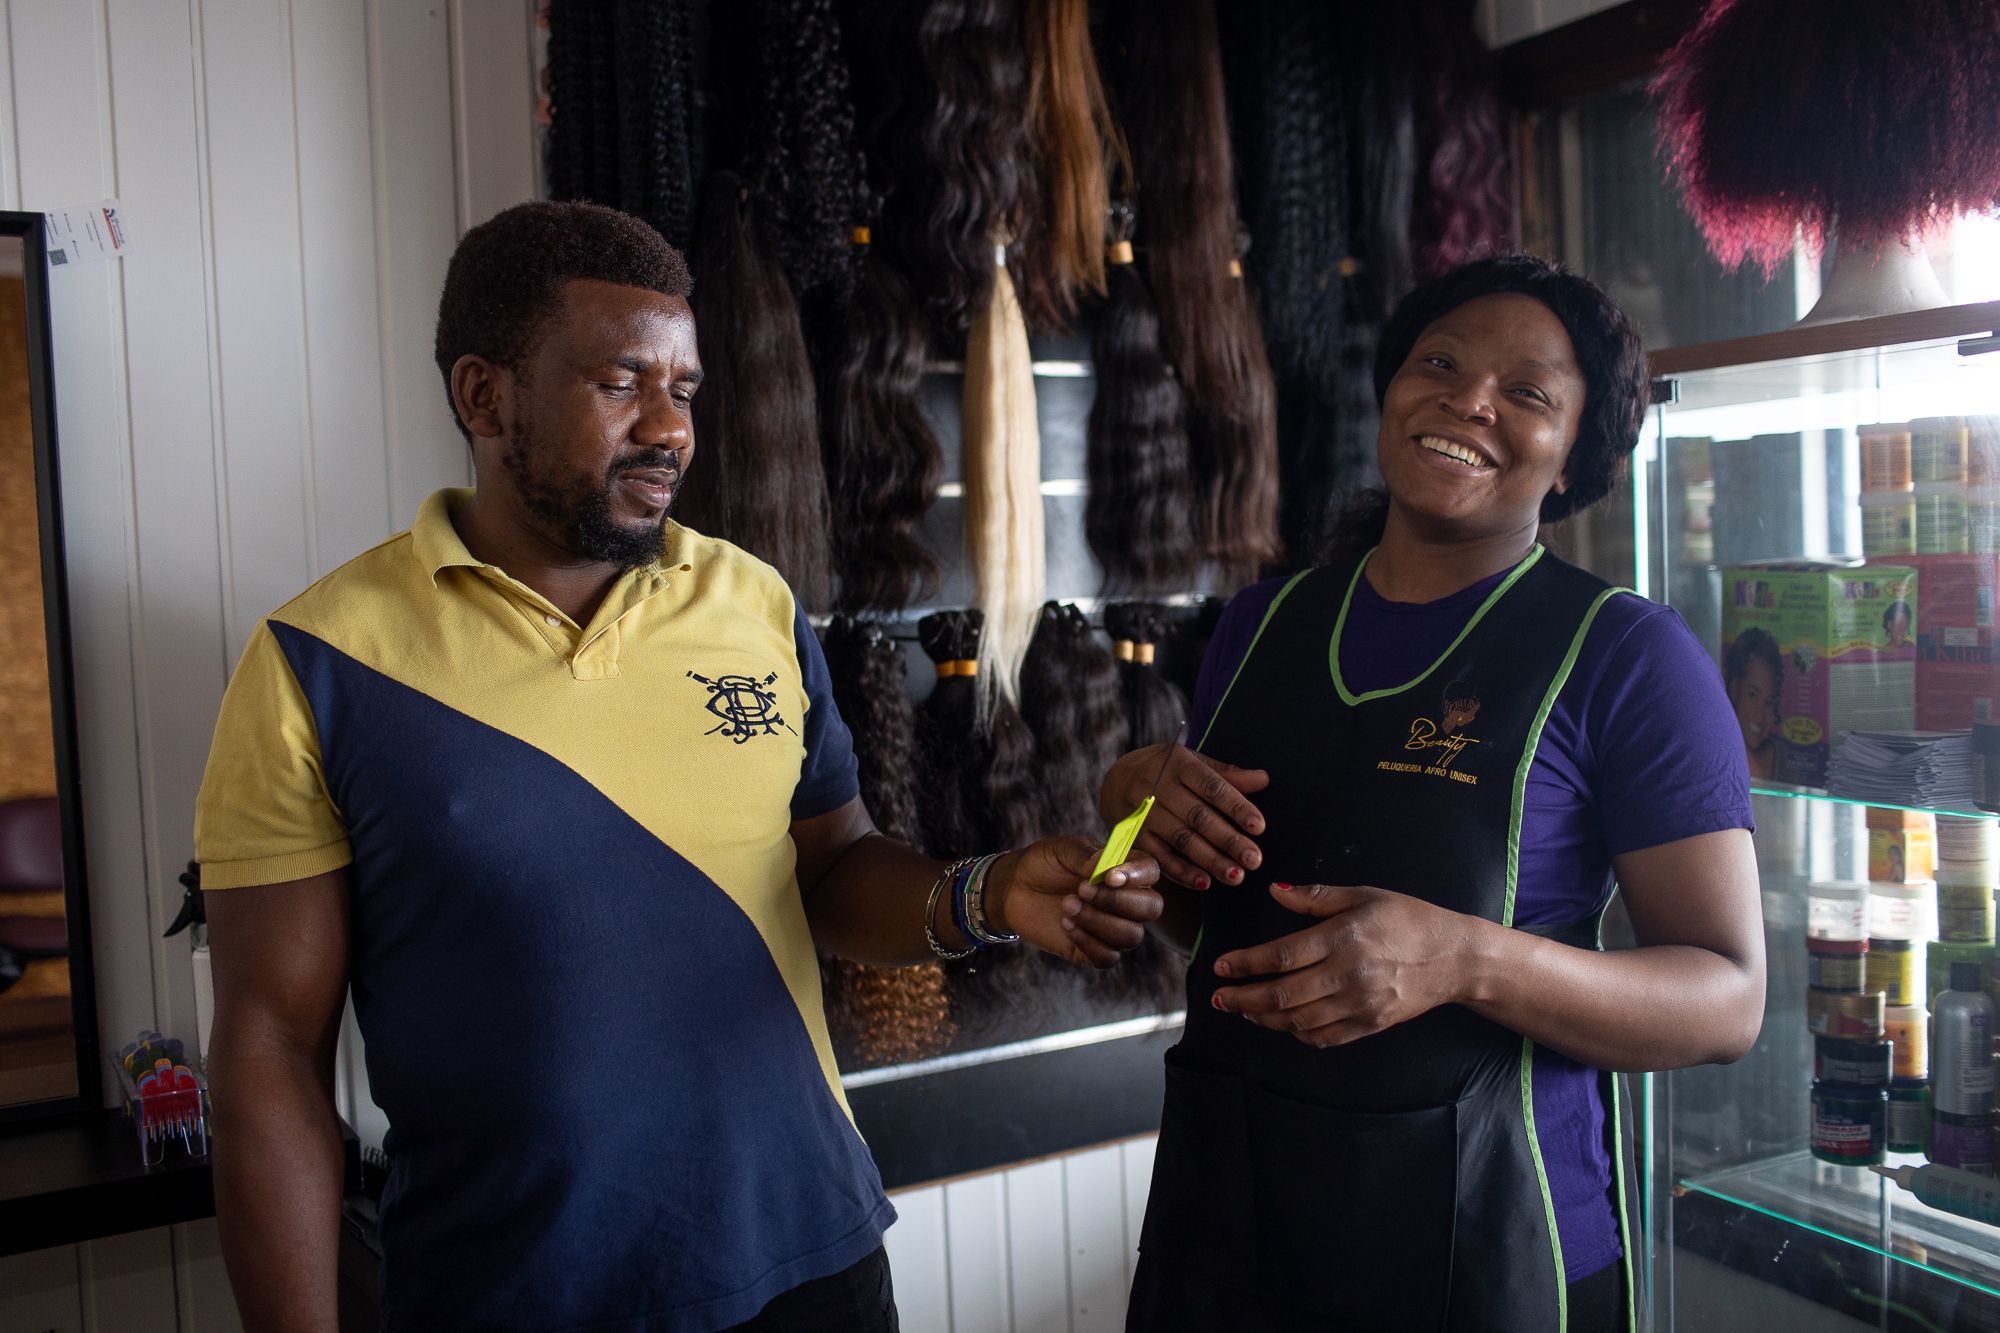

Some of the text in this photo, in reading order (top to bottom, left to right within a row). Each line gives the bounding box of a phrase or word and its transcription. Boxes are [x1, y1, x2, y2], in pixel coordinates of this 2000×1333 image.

[1377, 761, 1478, 785] PELUQUERIA AFRO UNISEX
